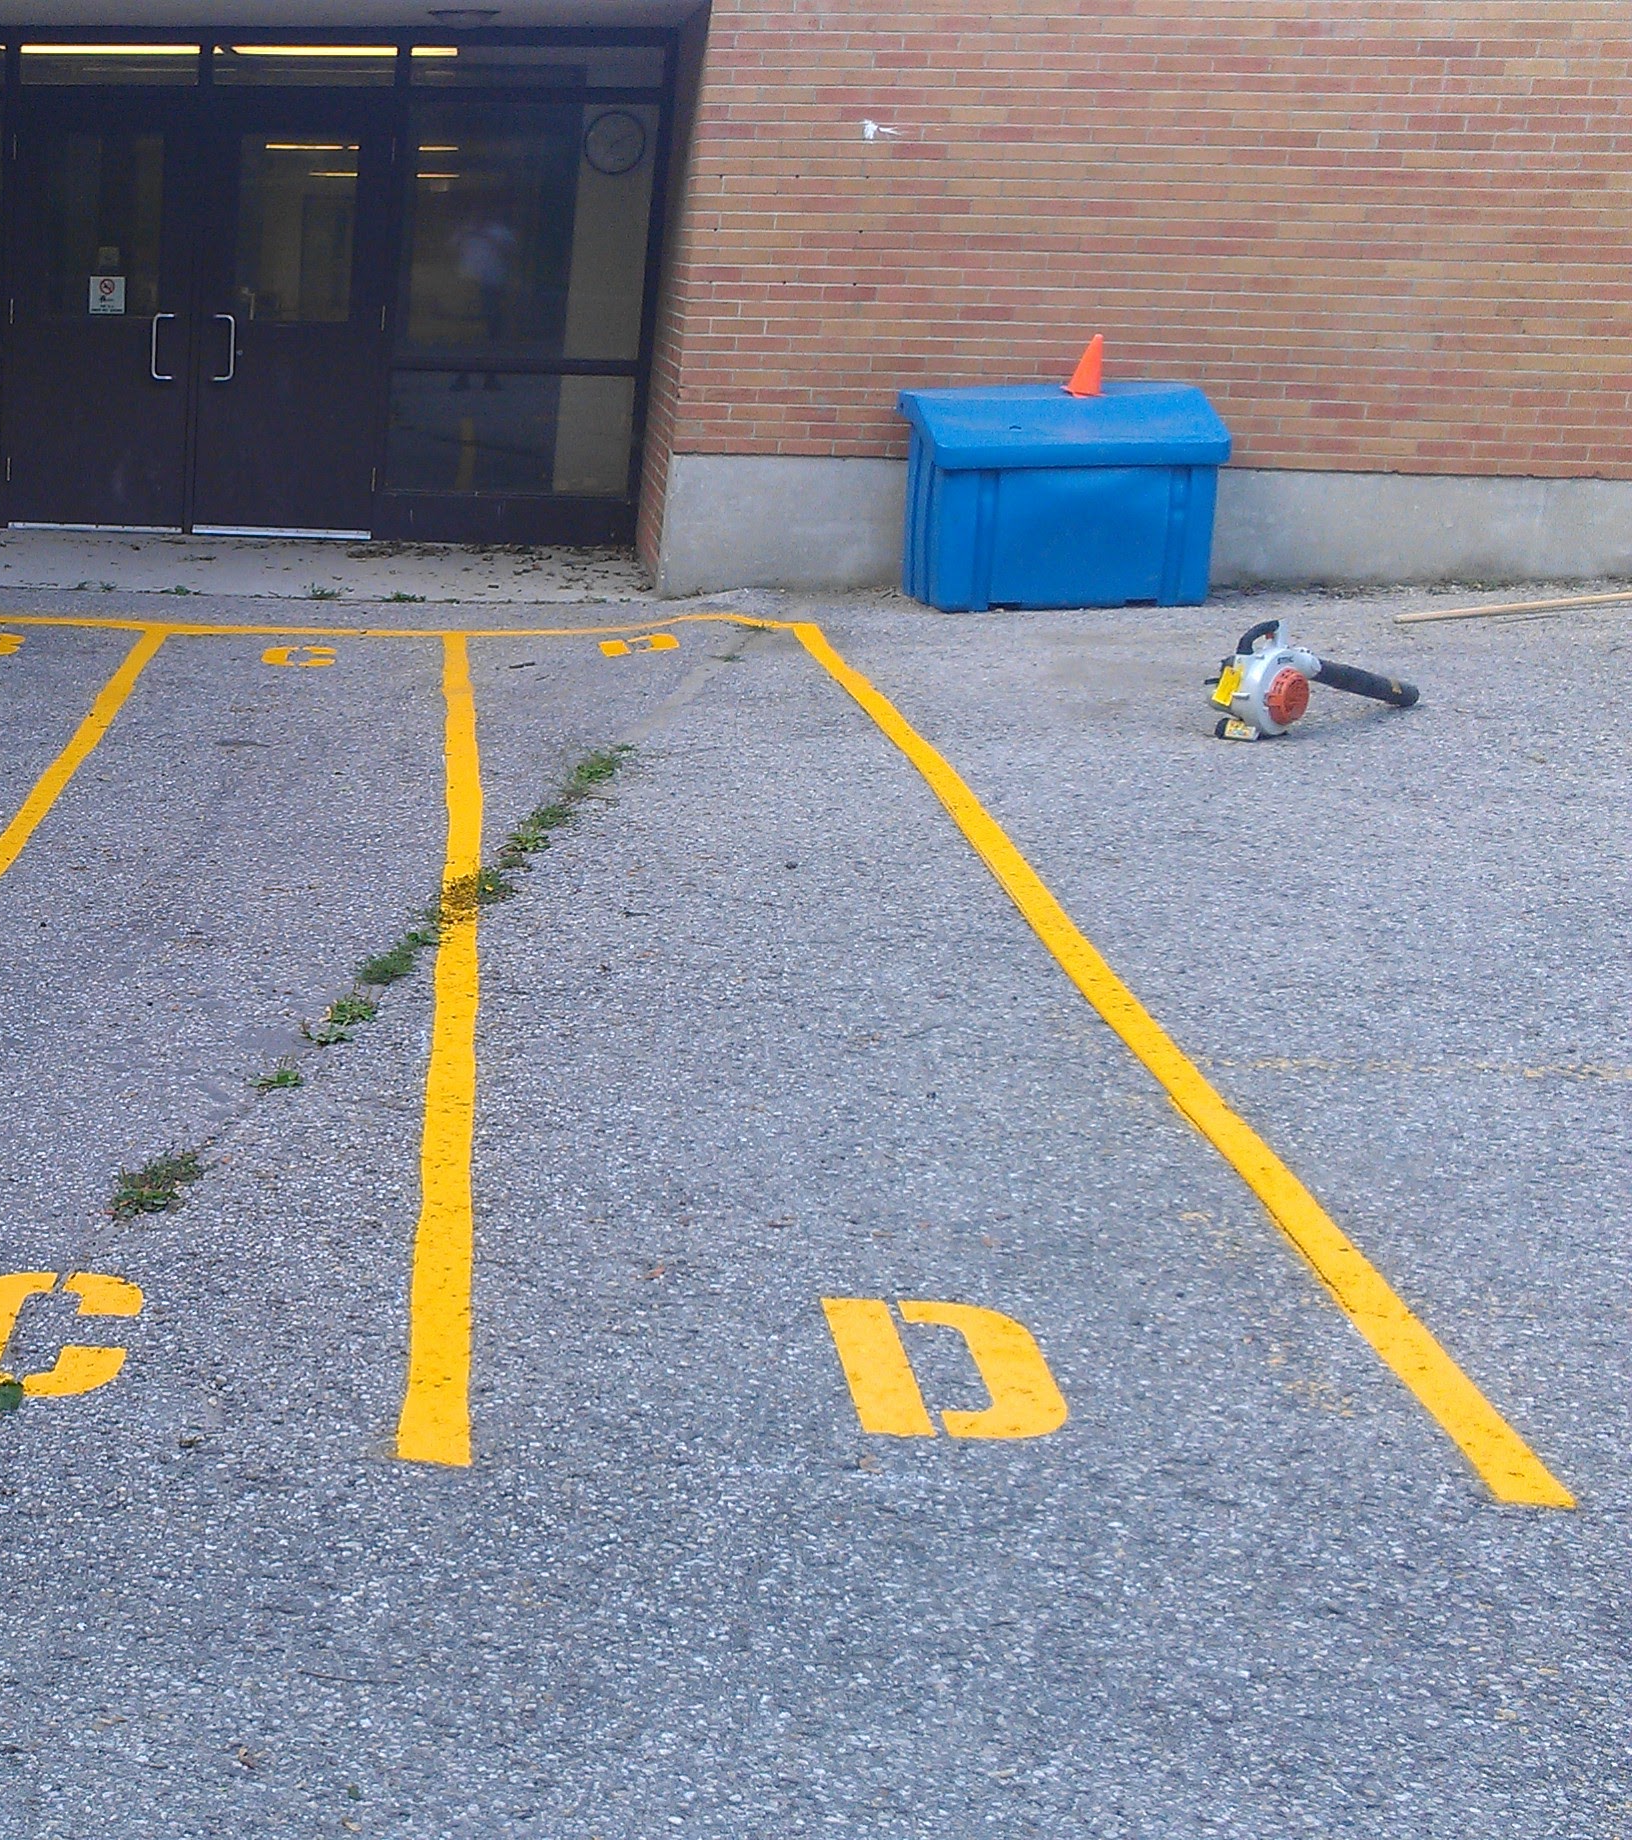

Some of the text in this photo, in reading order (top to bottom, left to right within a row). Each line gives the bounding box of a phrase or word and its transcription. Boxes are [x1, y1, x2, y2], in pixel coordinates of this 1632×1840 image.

[261, 646, 337, 667] C
[598, 633, 679, 657] D
[820, 1297, 1067, 1438] D
